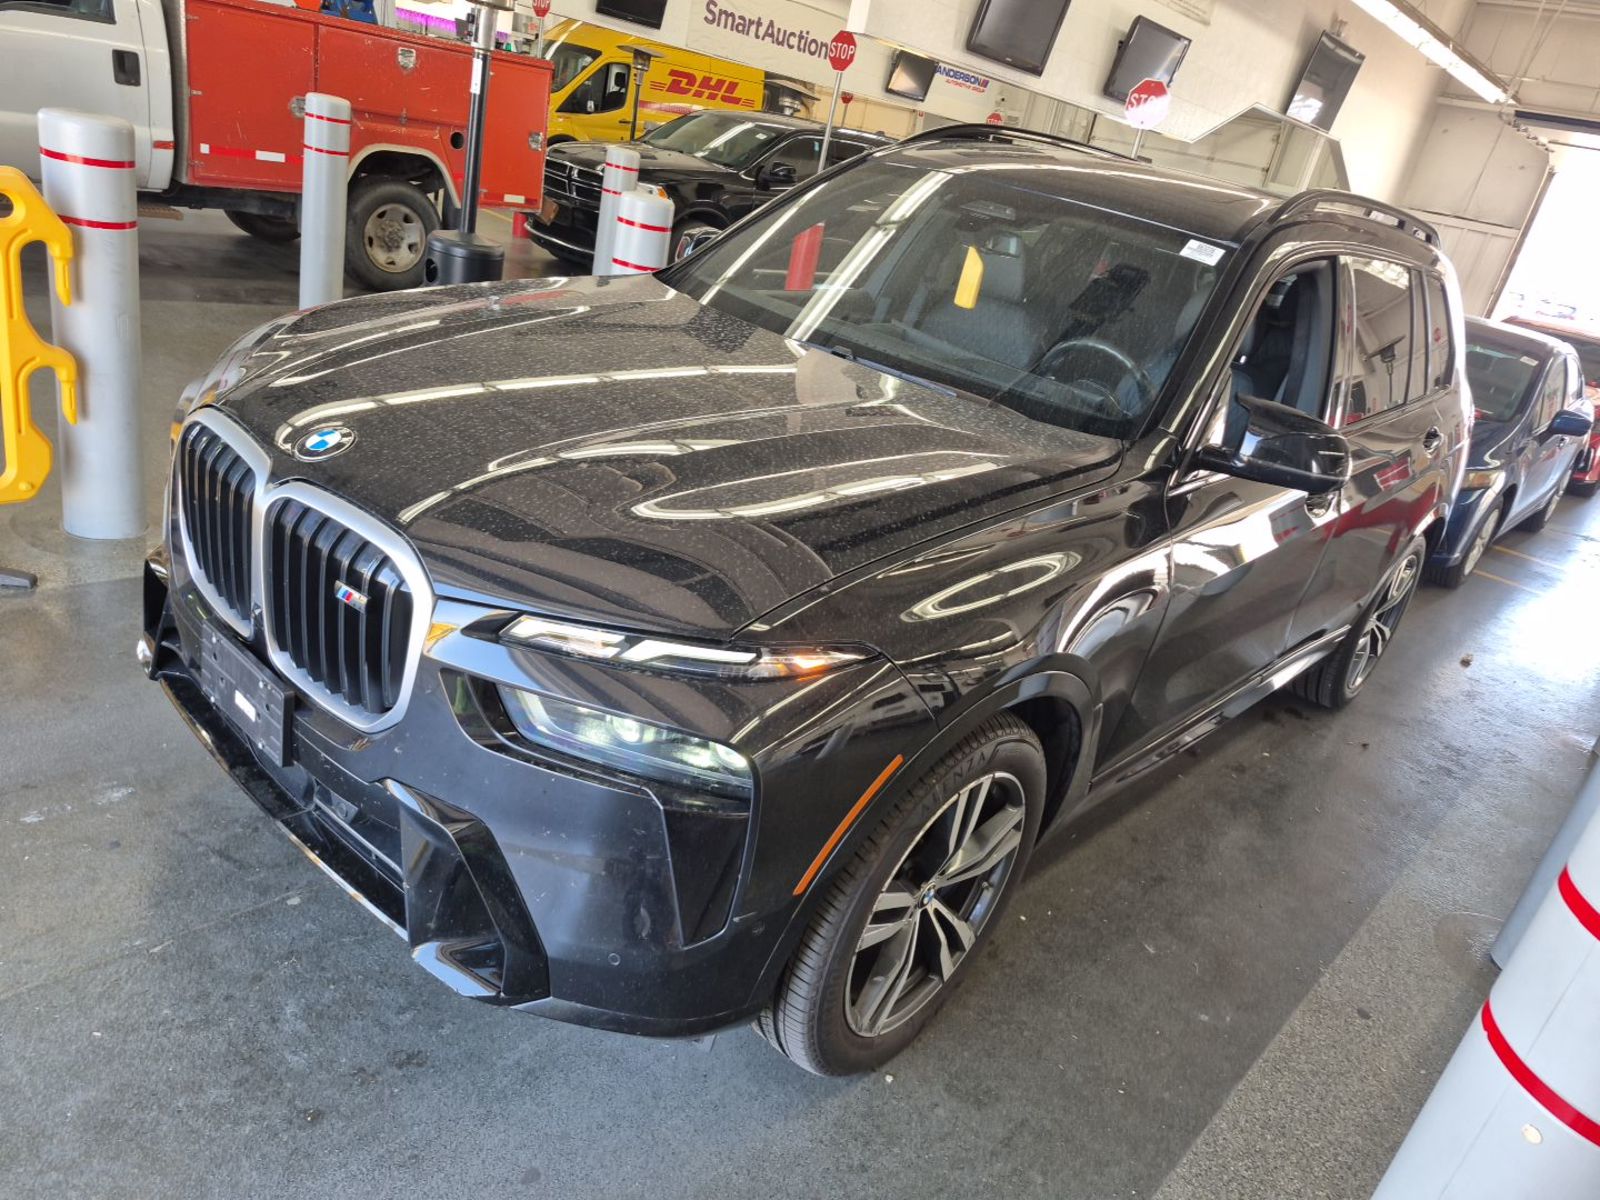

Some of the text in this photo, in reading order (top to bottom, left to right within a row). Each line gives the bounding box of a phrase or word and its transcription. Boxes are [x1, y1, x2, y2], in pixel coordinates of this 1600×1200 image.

[703, 0, 828, 60] SmartAuction
[830, 41, 855, 60] STOP
[665, 69, 742, 105] DHL
[936, 65, 982, 87] ANDERSON
